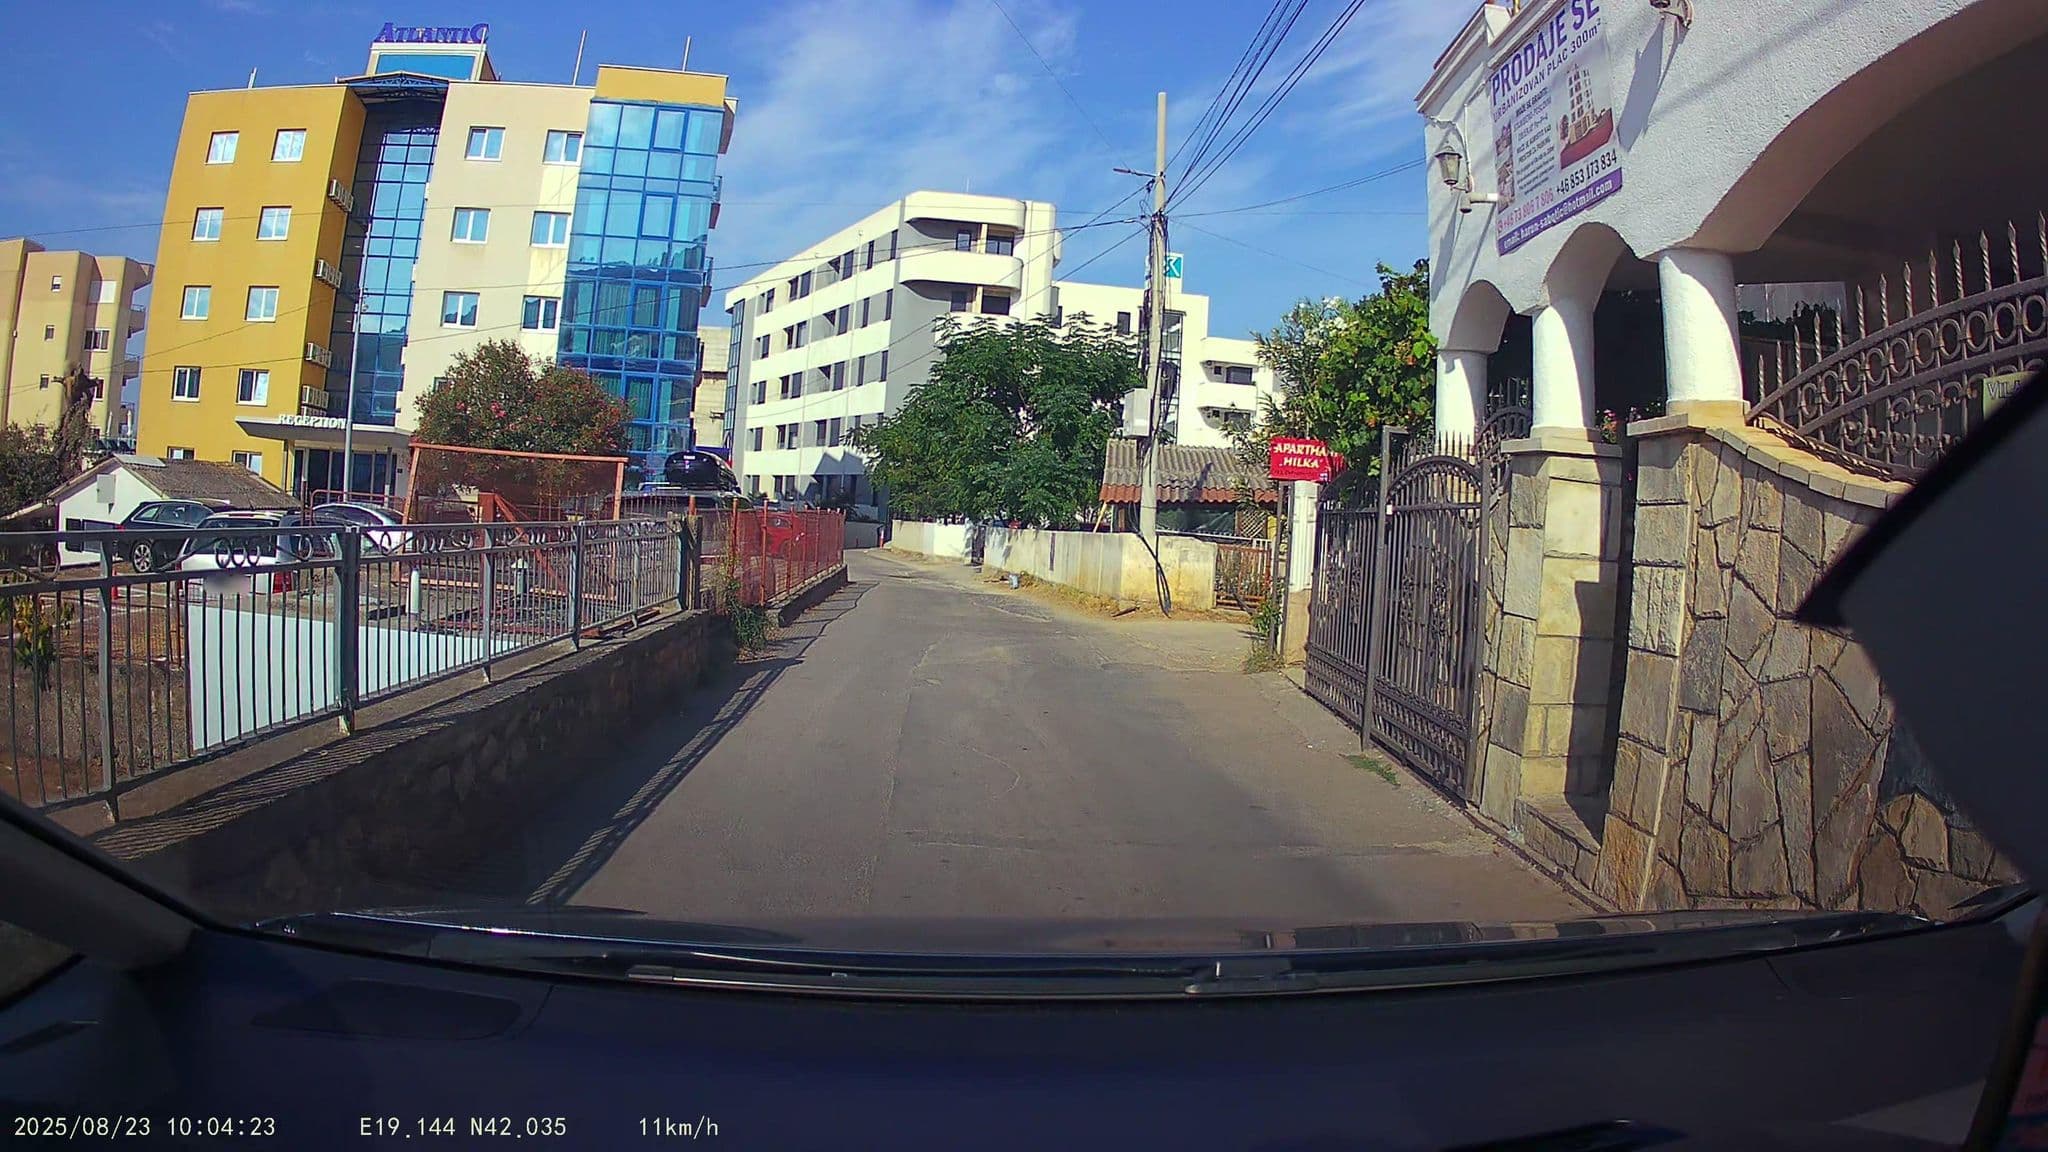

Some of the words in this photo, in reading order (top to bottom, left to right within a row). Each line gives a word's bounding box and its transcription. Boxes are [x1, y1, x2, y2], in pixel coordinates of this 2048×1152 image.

[374, 22, 489, 43] ATLANTIC
[1492, 9, 1567, 107] PRODAJE
[1571, 0, 1600, 30] SE
[1494, 69, 1545, 123] URBANIZOVAN
[1547, 48, 1568, 77] PLAC
[1556, 177, 1570, 196] +46
[1570, 168, 1585, 189] 853
[1586, 159, 1599, 180] 173
[1600, 148, 1617, 170] 834
[279, 414, 347, 430] RECEPTION
